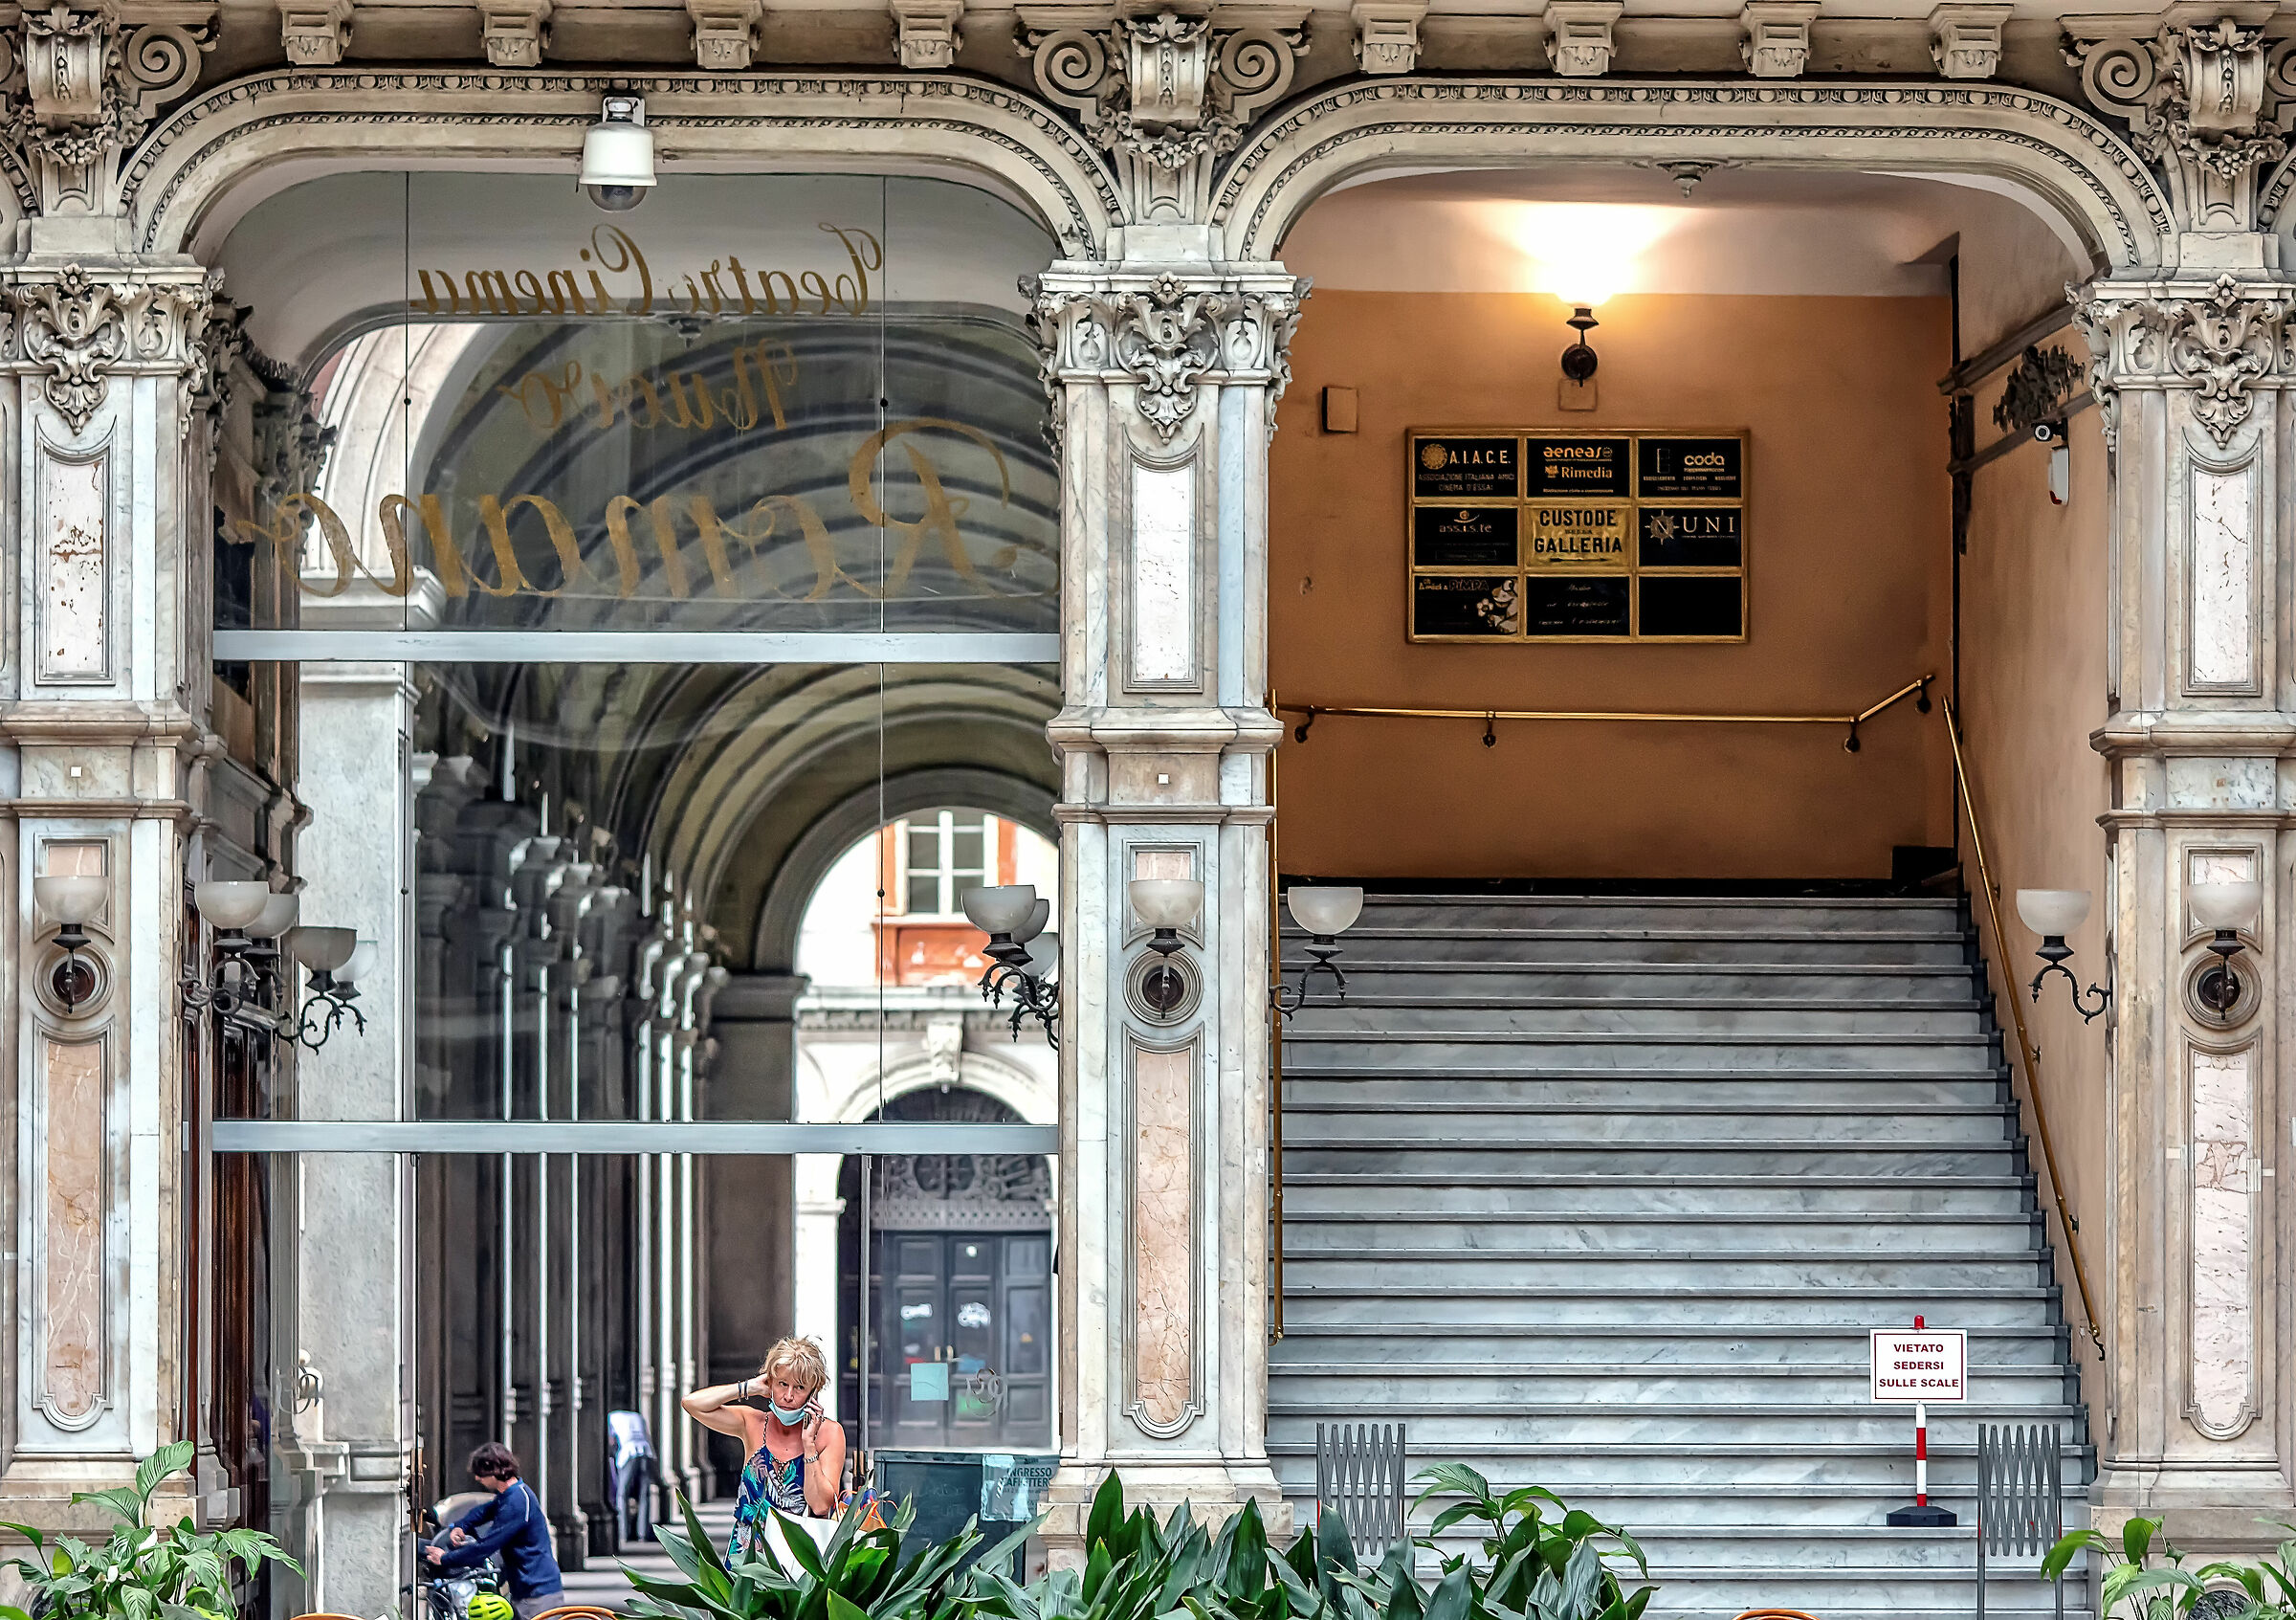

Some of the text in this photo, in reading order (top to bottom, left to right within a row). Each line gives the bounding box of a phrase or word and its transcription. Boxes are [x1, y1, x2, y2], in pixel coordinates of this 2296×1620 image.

[1684, 452, 1725, 466] coda
[1561, 466, 1613, 478] Rimedia
[1539, 510, 1617, 527] CUSTODE
[1534, 537, 1623, 553] GALLERIA
[1893, 1343, 1944, 1352] VIETATO
[1893, 1361, 1944, 1370] SEDERSI
[1879, 1379, 1959, 1387] SULLE SCALE
